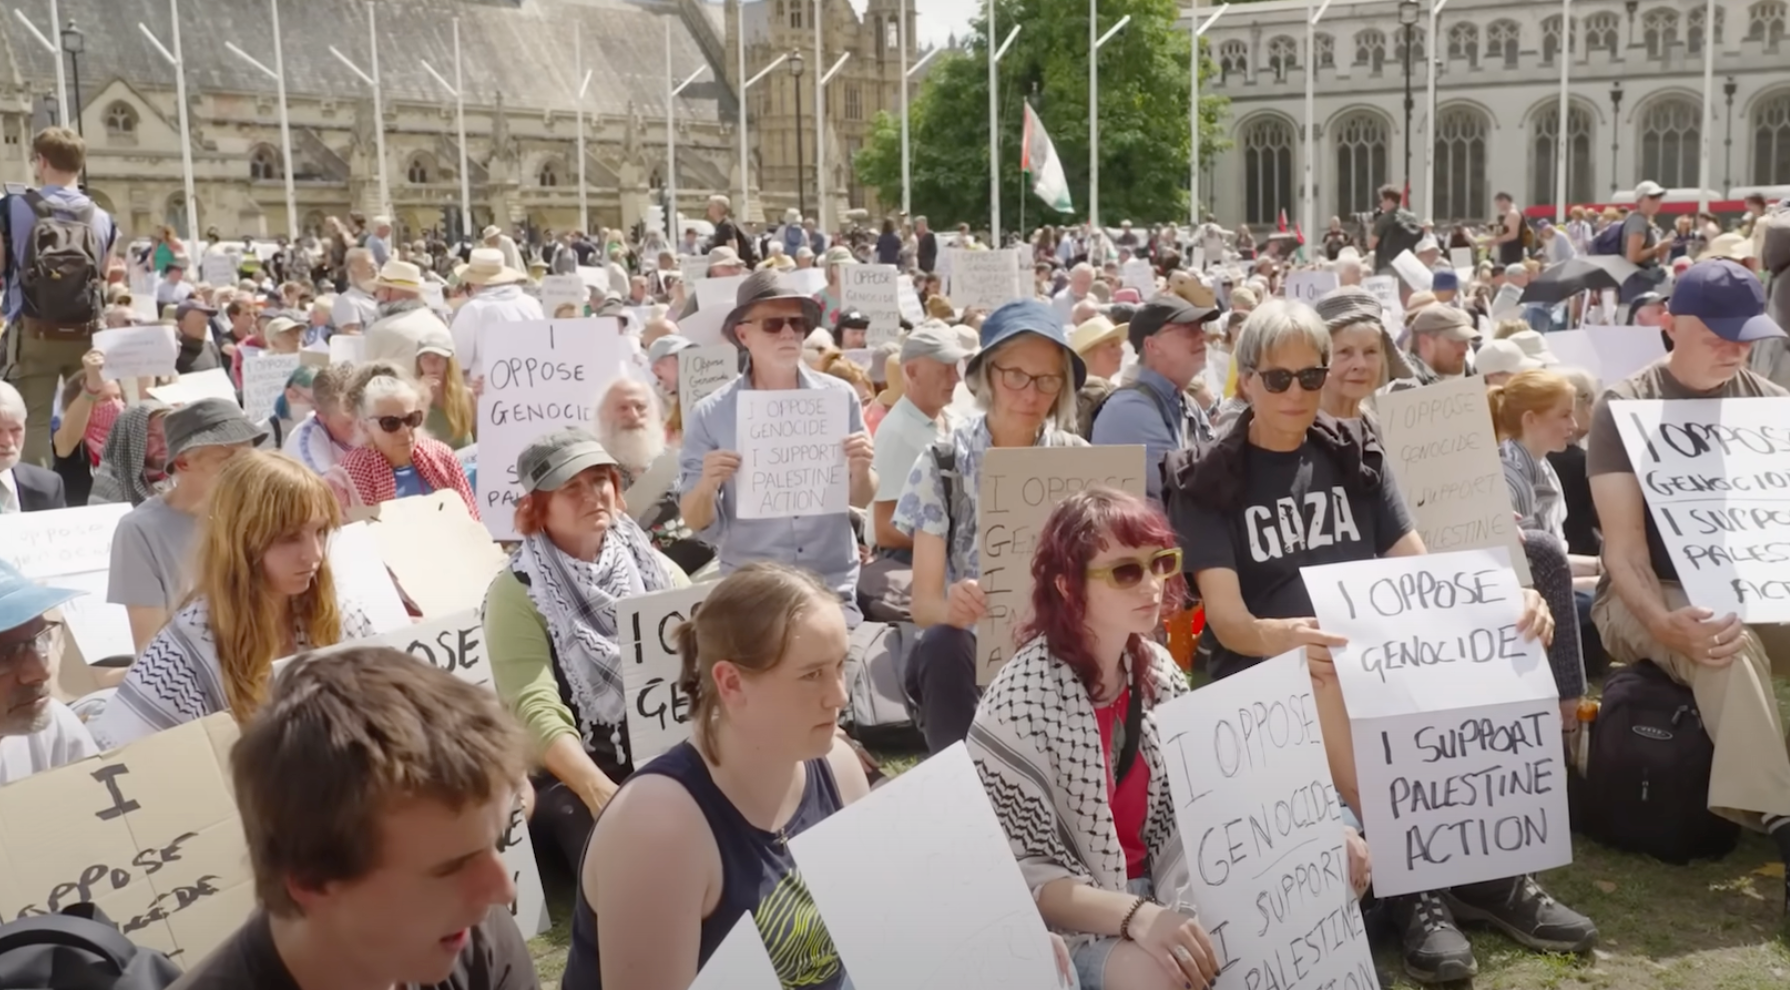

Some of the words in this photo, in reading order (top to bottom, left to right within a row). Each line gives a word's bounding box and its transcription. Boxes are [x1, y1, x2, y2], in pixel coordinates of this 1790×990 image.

[844, 267, 849, 285] I
[853, 268, 893, 286] OPPOSE
[549, 325, 555, 350] I
[490, 357, 585, 390] OPPOSE
[684, 355, 689, 374] I
[490, 400, 592, 426] GENOCID
[747, 401, 754, 420] I
[766, 398, 827, 418] OPPOSE
[749, 419, 828, 440] GENOCIDE
[1388, 407, 1395, 435] I
[1403, 392, 1477, 430] OPPOSE
[752, 448, 760, 468] I
[767, 443, 841, 465] SUPPORT
[1400, 432, 1482, 475] GENOCIDE
[1630, 412, 1661, 463] I
[752, 464, 844, 493] PALESTINE
[985, 474, 1010, 514] I
[1416, 472, 1499, 508] SUPPORT
[759, 487, 827, 515] ACTION
[1660, 507, 1683, 537] I
[1244, 486, 1361, 562] GAZA
[983, 566, 1013, 595] I
[1337, 580, 1357, 620] I
[1368, 568, 1507, 617] OPPOSE
[632, 611, 643, 664] I
[1360, 624, 1527, 684] GENOCIDE
[1166, 730, 1214, 808] I
[1213, 693, 1321, 779] OPPOSE
[1381, 731, 1393, 765] I
[1414, 711, 1550, 764] SUPPORT
[90, 763, 141, 821] I
[1389, 758, 1553, 820] PALESTINE
[1197, 780, 1342, 887] GENOCIDE
[1406, 807, 1548, 871] ACTION
[1209, 920, 1241, 972] I
[1256, 845, 1345, 937] SUPPORT
[1244, 897, 1364, 990] PALESTINE
